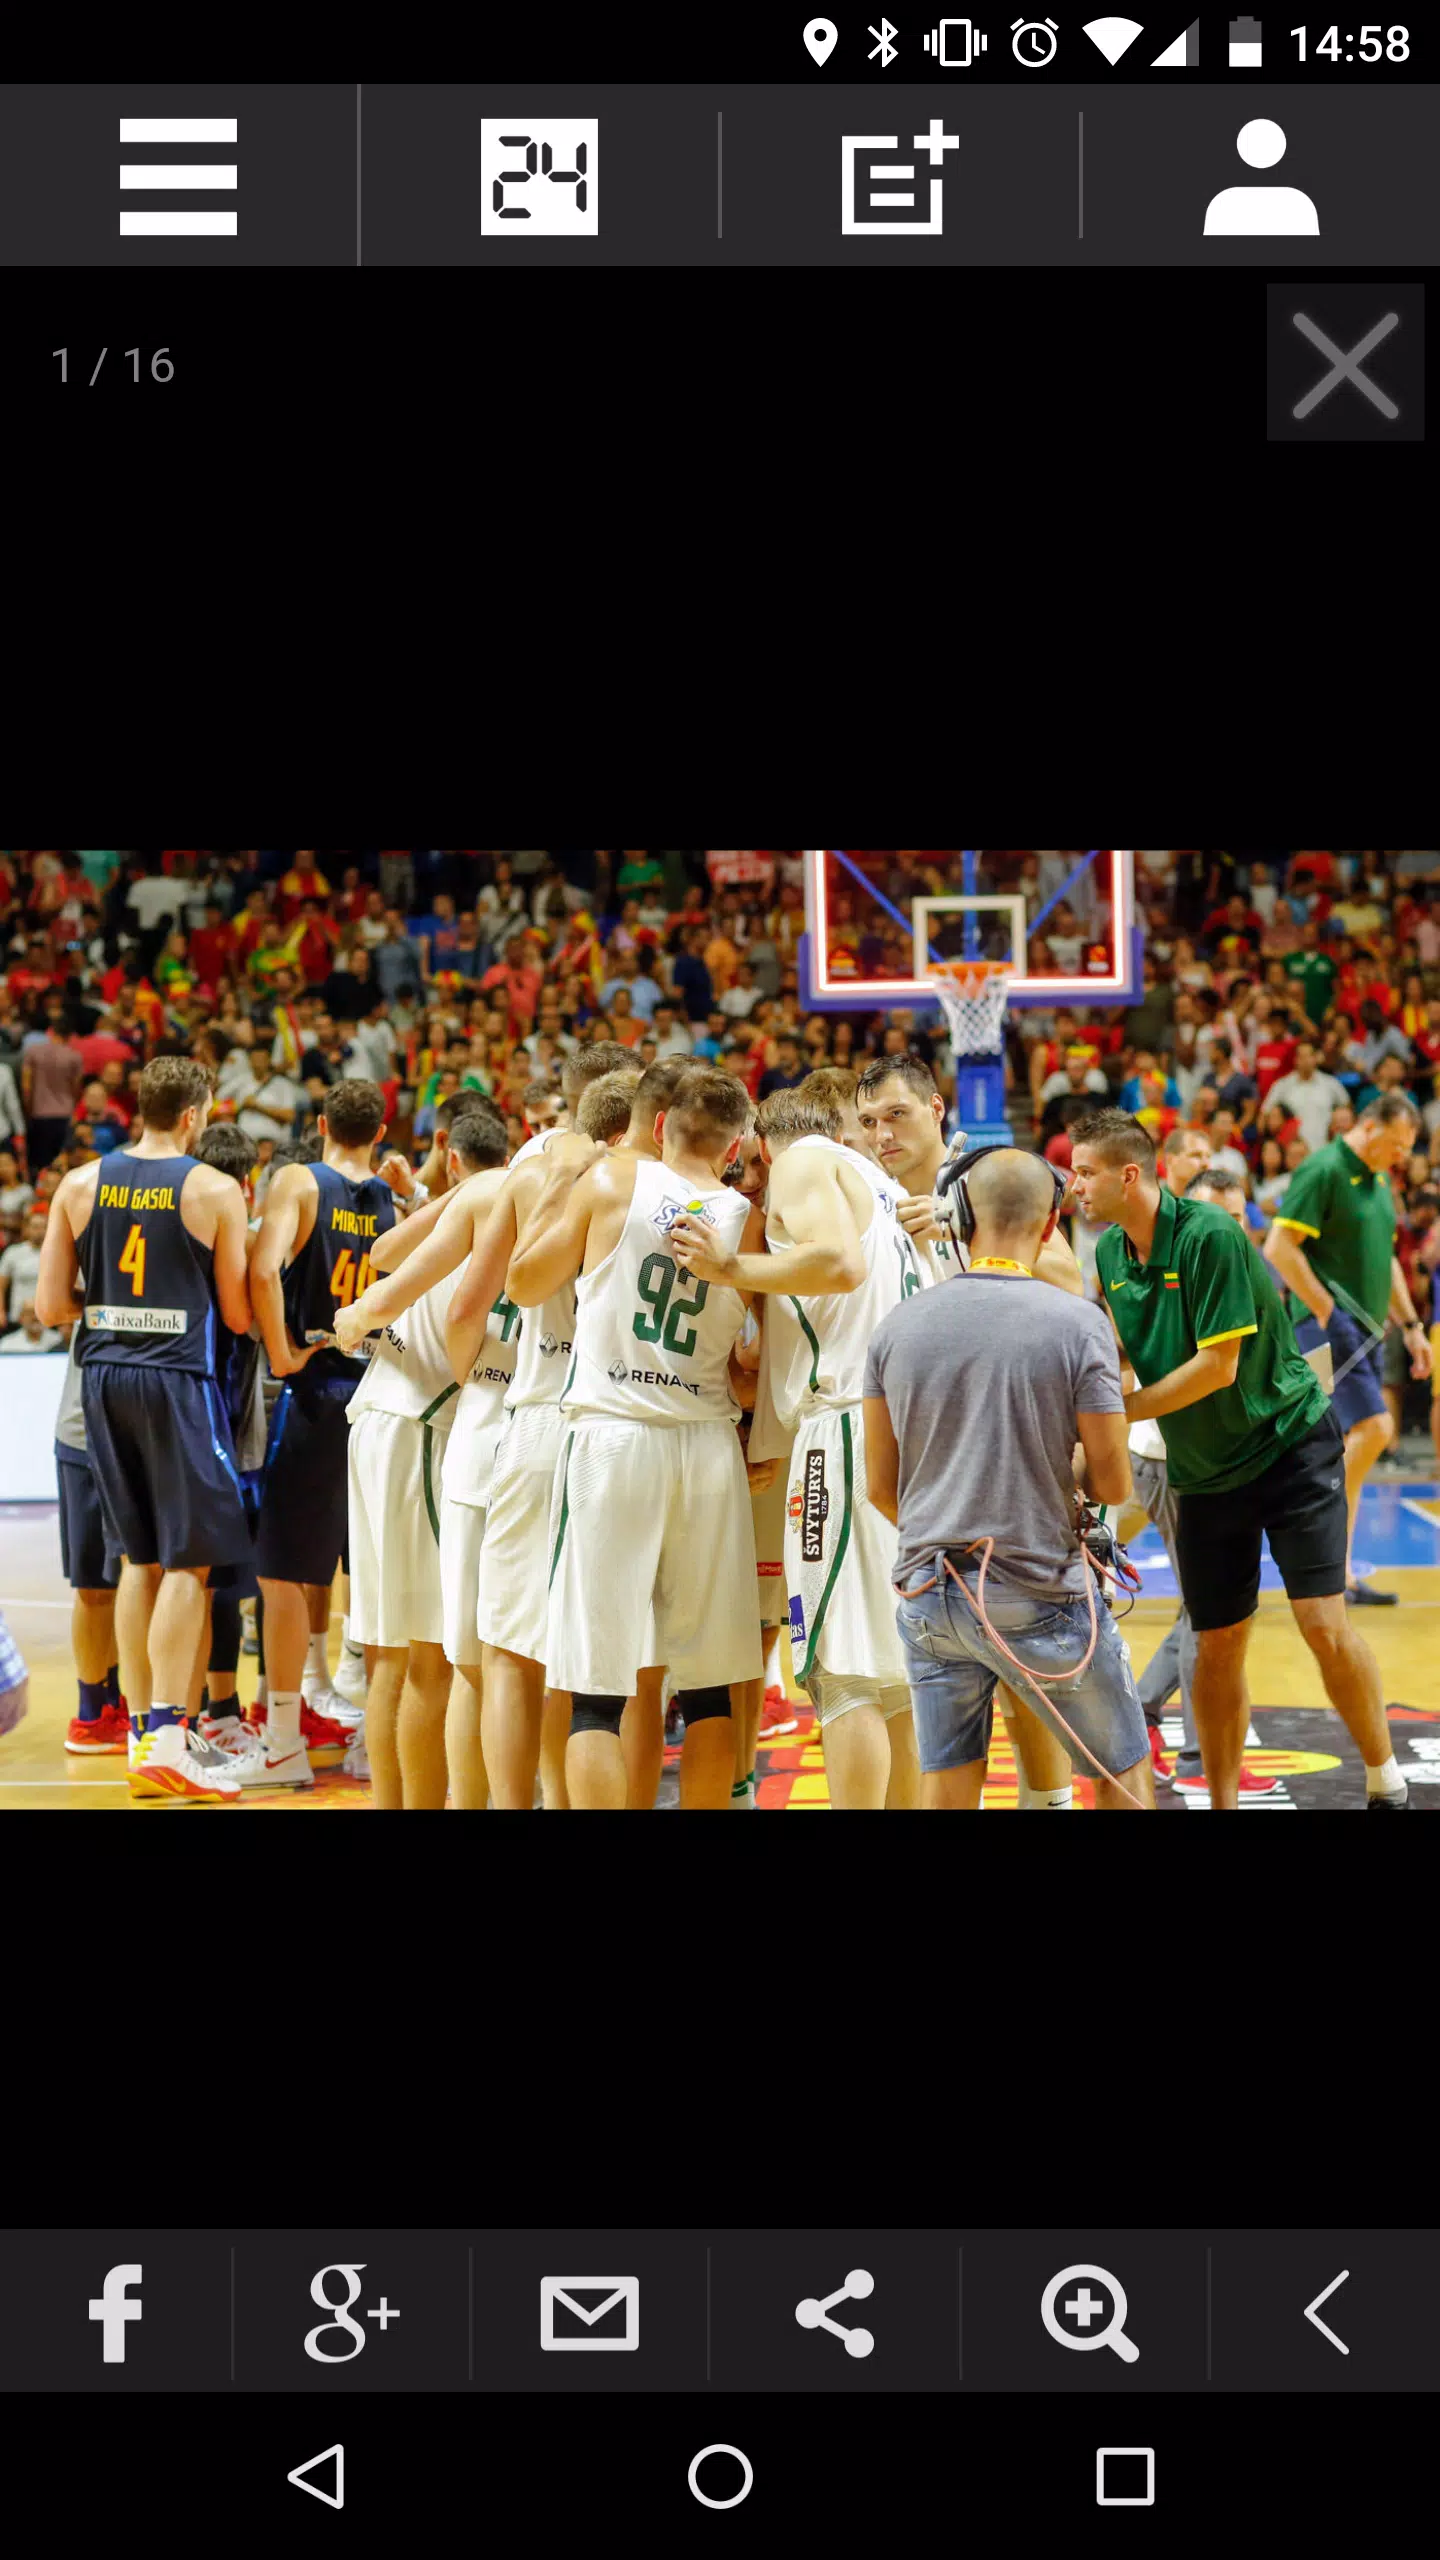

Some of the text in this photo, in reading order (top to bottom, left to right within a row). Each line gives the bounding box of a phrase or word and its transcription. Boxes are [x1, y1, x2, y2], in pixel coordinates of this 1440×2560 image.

[1290, 25, 1411, 63] 14:58
[493, 136, 587, 219] 24
[53, 348, 175, 386] 1 / 16
[99, 1184, 176, 1211] PAU GASOL
[118, 1224, 147, 1297] 4
[632, 1252, 710, 1357] 92
[803, 1455, 823, 1557] ŠVYTURYS
